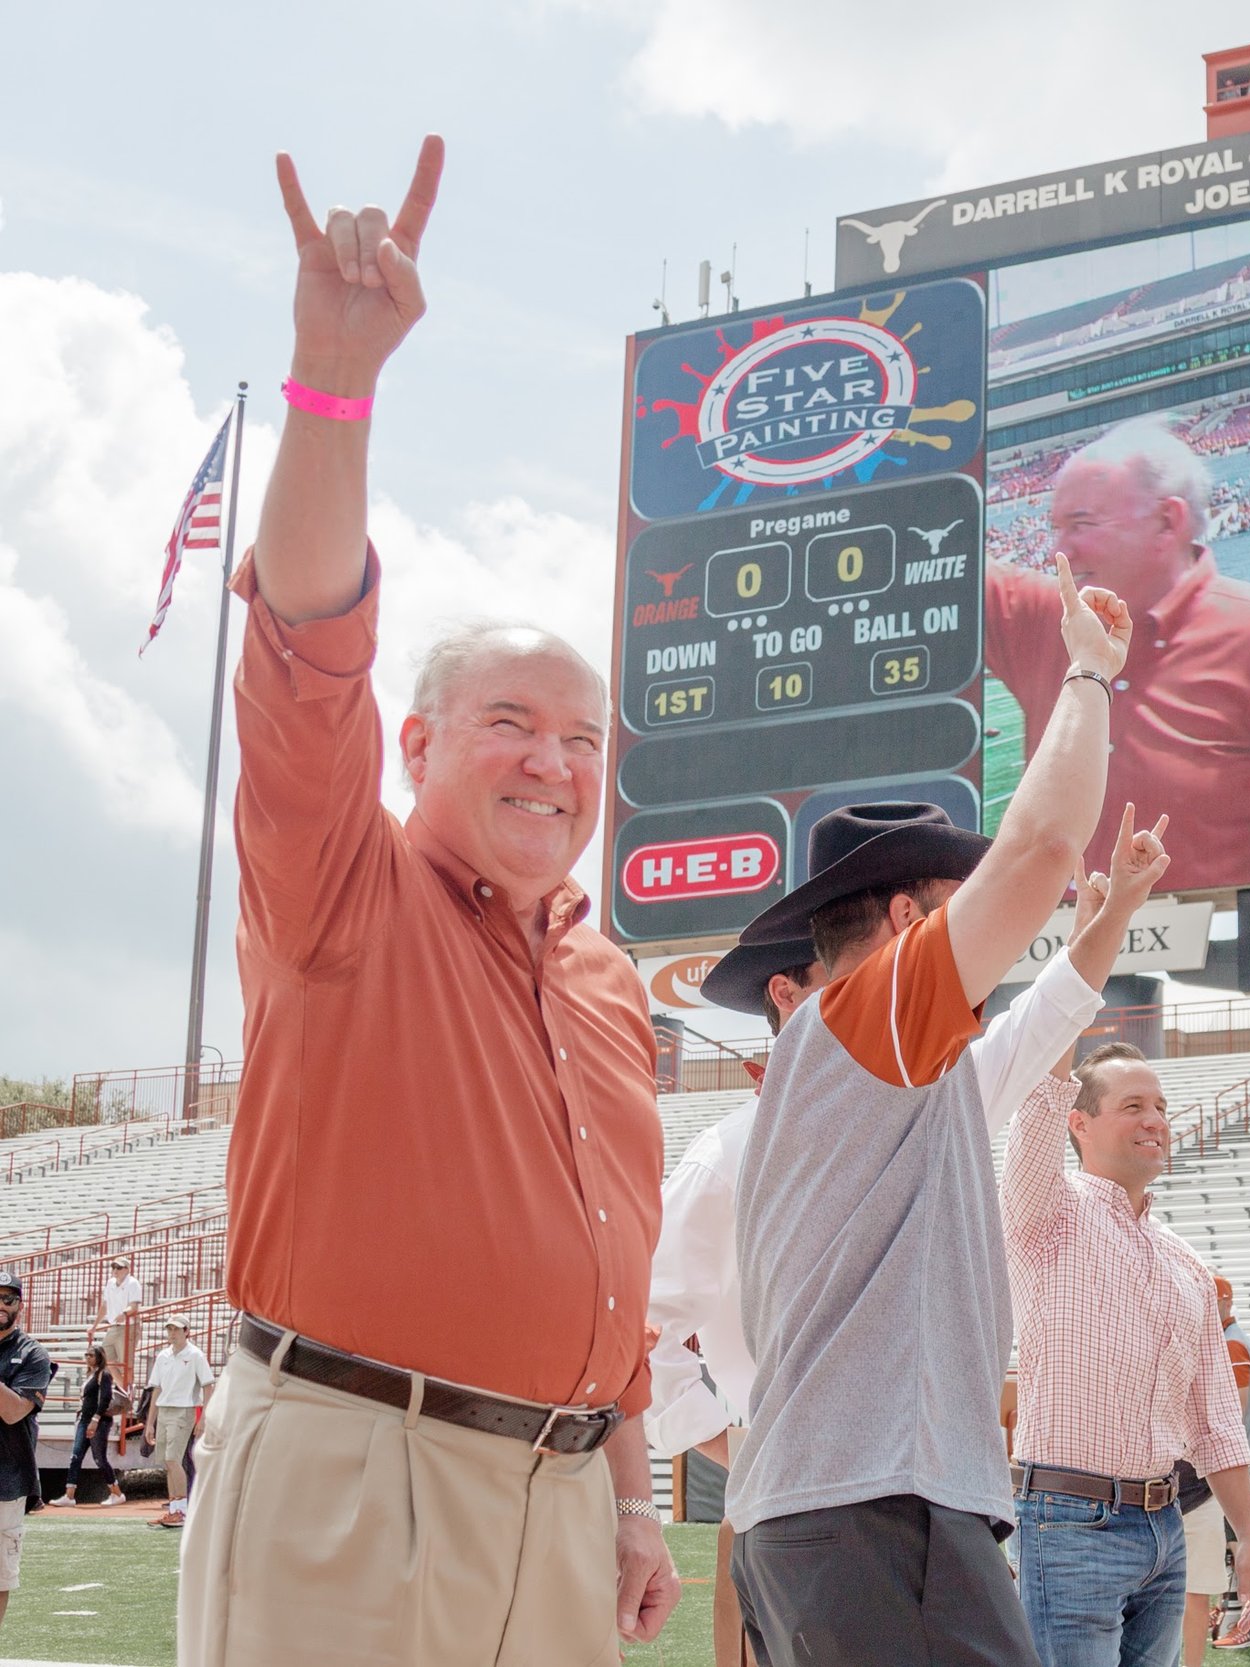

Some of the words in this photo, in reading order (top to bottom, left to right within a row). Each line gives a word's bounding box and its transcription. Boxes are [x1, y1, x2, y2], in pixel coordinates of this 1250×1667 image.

[952, 178, 1094, 226] DARRELL
[1104, 171, 1129, 196] K
[1138, 150, 1243, 190] ROYAL
[1185, 180, 1250, 214] JOE
[748, 353, 869, 394] FIVE
[736, 378, 876, 420] STAR
[714, 408, 896, 459] PAINTING
[751, 508, 851, 538] Pregame
[736, 563, 762, 598] 0
[837, 547, 864, 582] 0
[904, 554, 967, 586] WHITE
[633, 596, 700, 627] ORANGE
[854, 611, 916, 645] BALL
[924, 605, 959, 634] ON
[646, 641, 717, 675] DOWN
[753, 631, 782, 659] TO
[790, 625, 822, 653] GO
[769, 674, 802, 700] 10
[884, 657, 920, 685] 35
[654, 687, 707, 717] 1ST
